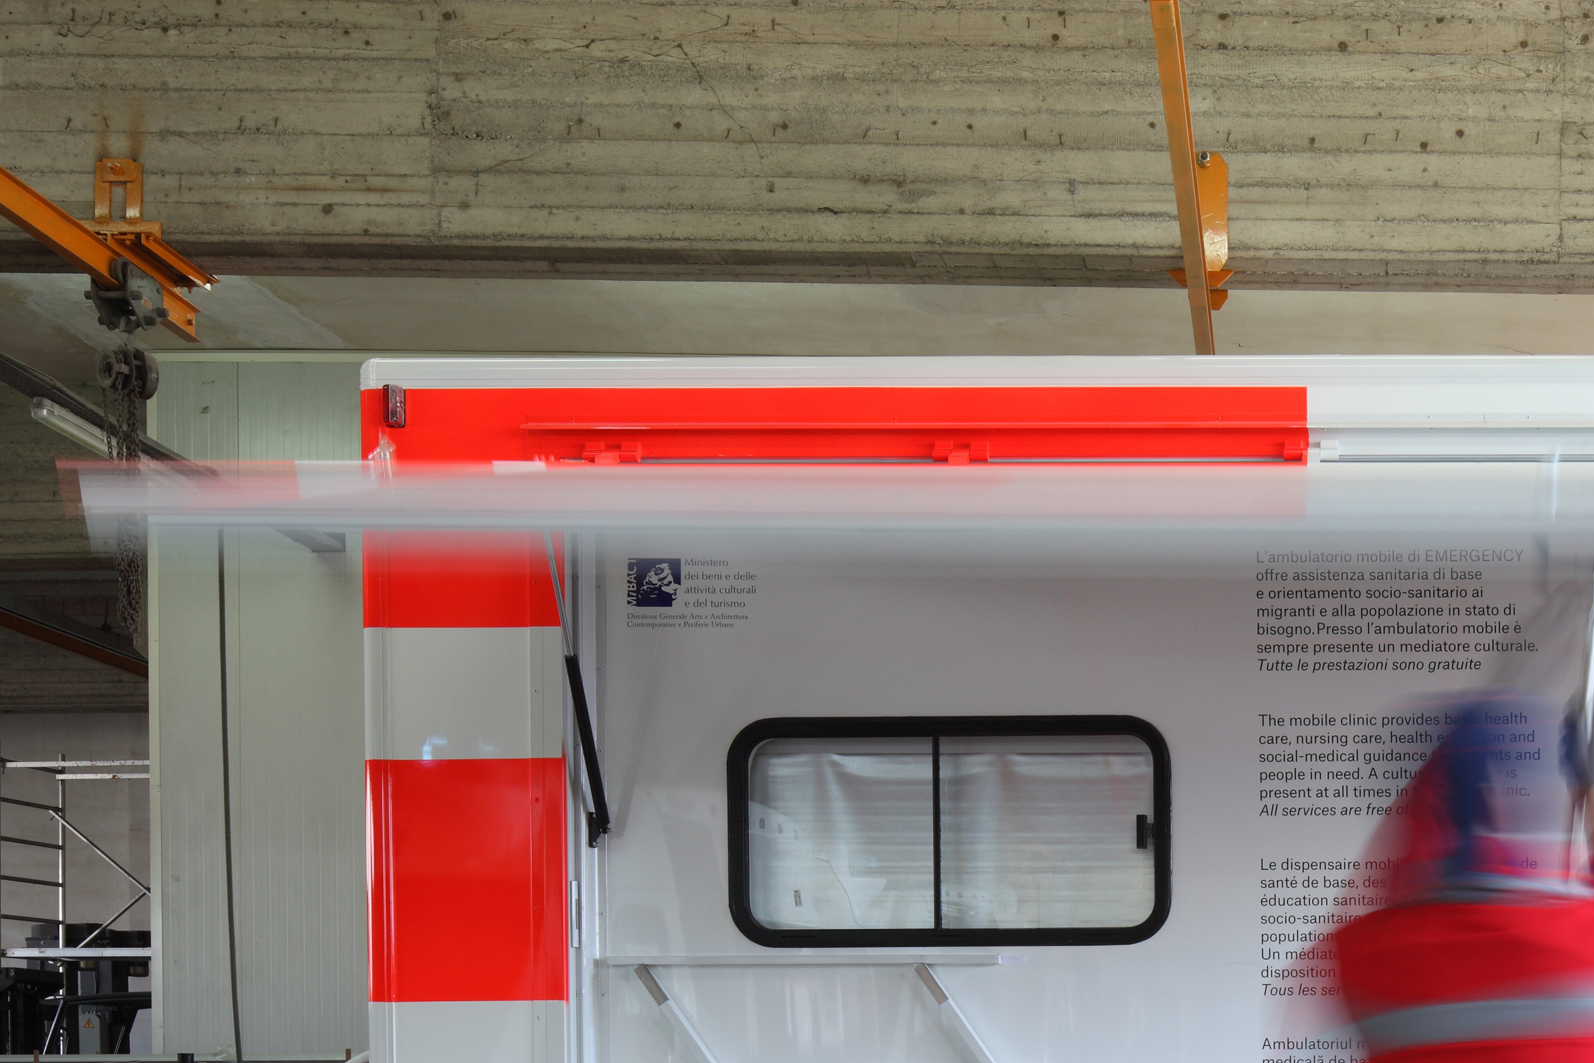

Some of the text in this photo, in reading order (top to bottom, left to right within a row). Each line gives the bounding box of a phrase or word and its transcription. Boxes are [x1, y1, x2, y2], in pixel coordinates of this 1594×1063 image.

[685, 558, 728, 566] Ministero
[1256, 549, 1524, 563] L'ambulatorio mobile di EMERGENCY
[685, 572, 698, 580] dei
[702, 572, 722, 580] beni
[734, 571, 756, 580] delle
[1256, 568, 1482, 581] offre assistenza sanitaria di base
[684, 585, 756, 594] attività culturali
[1256, 586, 1483, 599] e orientamento socio-sanitario ai
[693, 599, 707, 607] del
[1257, 603, 1516, 620] migranti e alla popolazione in stato di
[627, 621, 676, 629] Contemporanee
[1257, 621, 1522, 638] bisogno. Presso l'ambulatorio mobile è
[1257, 639, 1539, 655] sempre presente un mediatore culturale.
[1258, 658, 1482, 673] Tutte le prestazioni sono gratuite
[1259, 714, 1285, 726] The
[1289, 714, 1336, 726] mobile
[1340, 713, 1377, 726] clinic
[1381, 713, 1440, 728] provides
[1485, 712, 1528, 724] health
[1259, 736, 1292, 746] care,
[1296, 732, 1348, 746] nursing
[1352, 735, 1386, 745] care,
[1390, 731, 1432, 743] health
[1509, 730, 1534, 742] and
[1259, 749, 1359, 762] social-medical
[1363, 749, 1428, 764] guidance
[1515, 748, 1540, 760] and
[1259, 768, 1305, 783] people
[1309, 768, 1322, 780] in
[1327, 767, 1364, 780] need.
[1368, 767, 1378, 779] A
[1382, 767, 1420, 779] cultu
[1506, 769, 1517, 778] is
[1259, 785, 1312, 801] present
[1316, 787, 1329, 798] at
[1333, 785, 1348, 798] all
[1352, 786, 1391, 797] times
[1396, 785, 1408, 797] in
[1259, 804, 1278, 816] All
[1282, 804, 1336, 816] services
[1340, 807, 1362, 815] are
[1366, 803, 1392, 815] free
[1260, 858, 1400, 873] Le dispensaire mobi
[1260, 876, 1387, 889] santé de base, des
[1260, 894, 1392, 906] éducation sanitaire
[1261, 947, 1340, 960] Un médiate
[1261, 965, 1336, 980] disposition
[1262, 984, 1294, 996] Tous
[1298, 983, 1316, 996] les
[1262, 1038, 1352, 1050] Ambulatoriul
